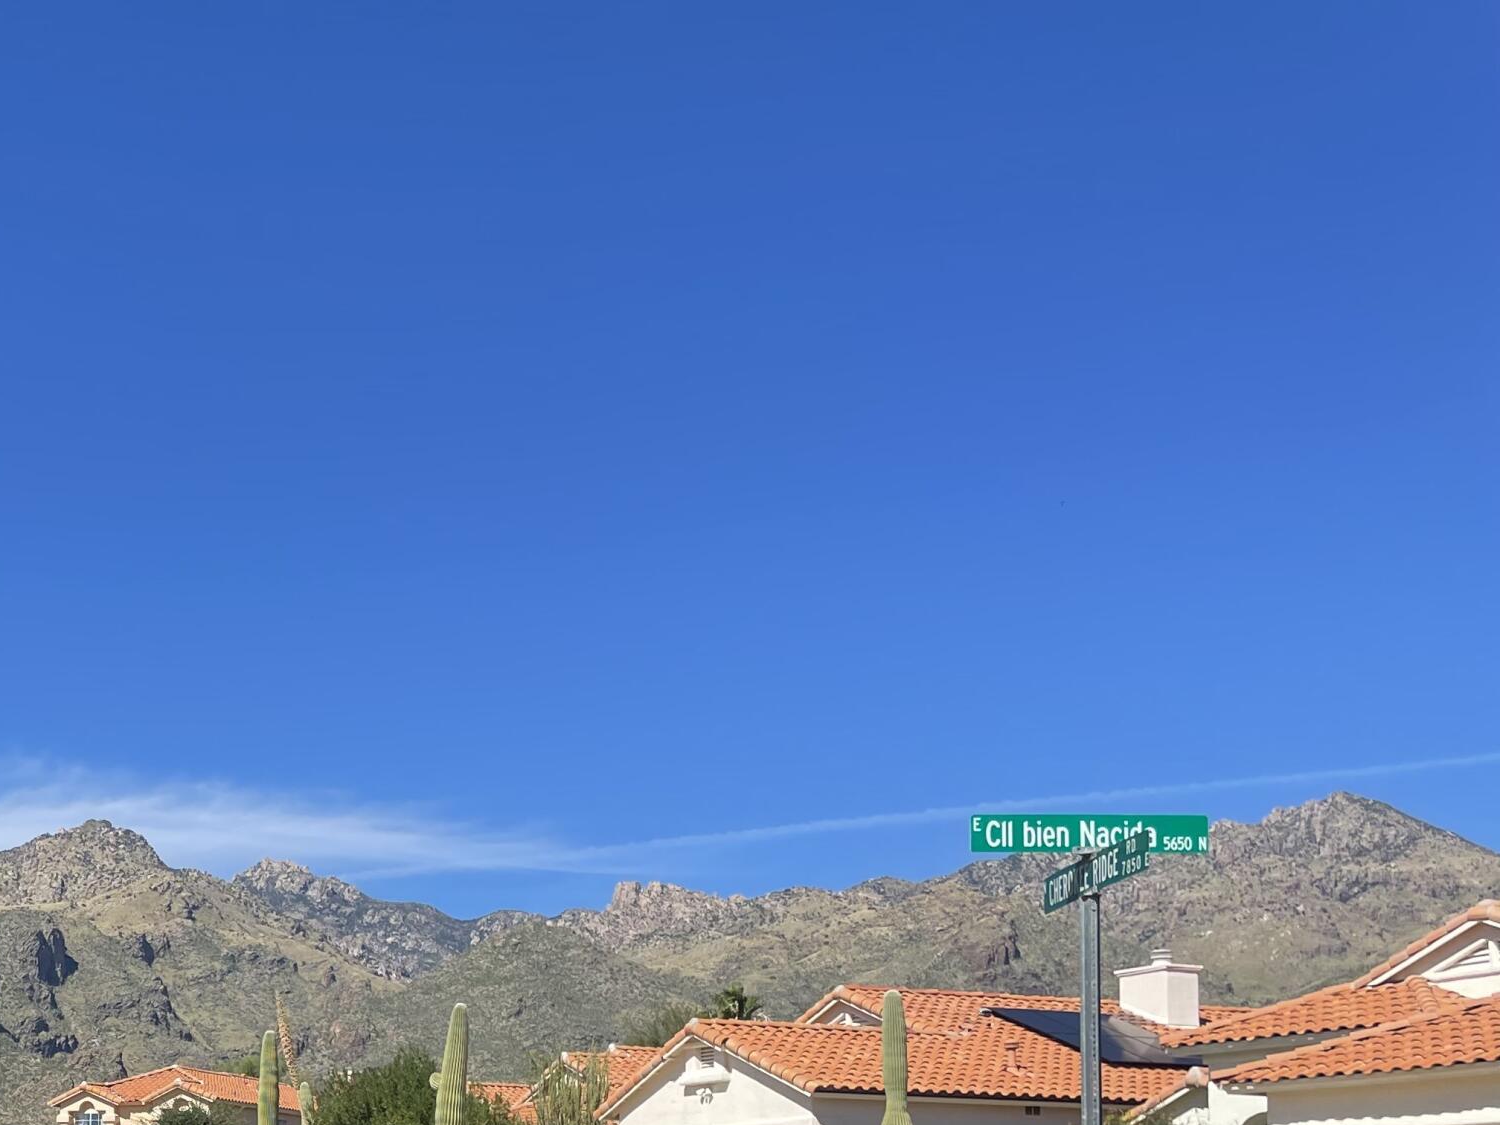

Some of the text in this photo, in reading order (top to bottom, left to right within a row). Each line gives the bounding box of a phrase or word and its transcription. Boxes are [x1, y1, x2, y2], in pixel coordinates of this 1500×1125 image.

[973, 817, 981, 832] E
[1023, 820, 1070, 848] bien
[1163, 836, 1207, 851] 5650 N
[1125, 838, 1136, 855] RD
[1092, 848, 1119, 885] RIDGE
[1121, 854, 1141, 876] 7850
